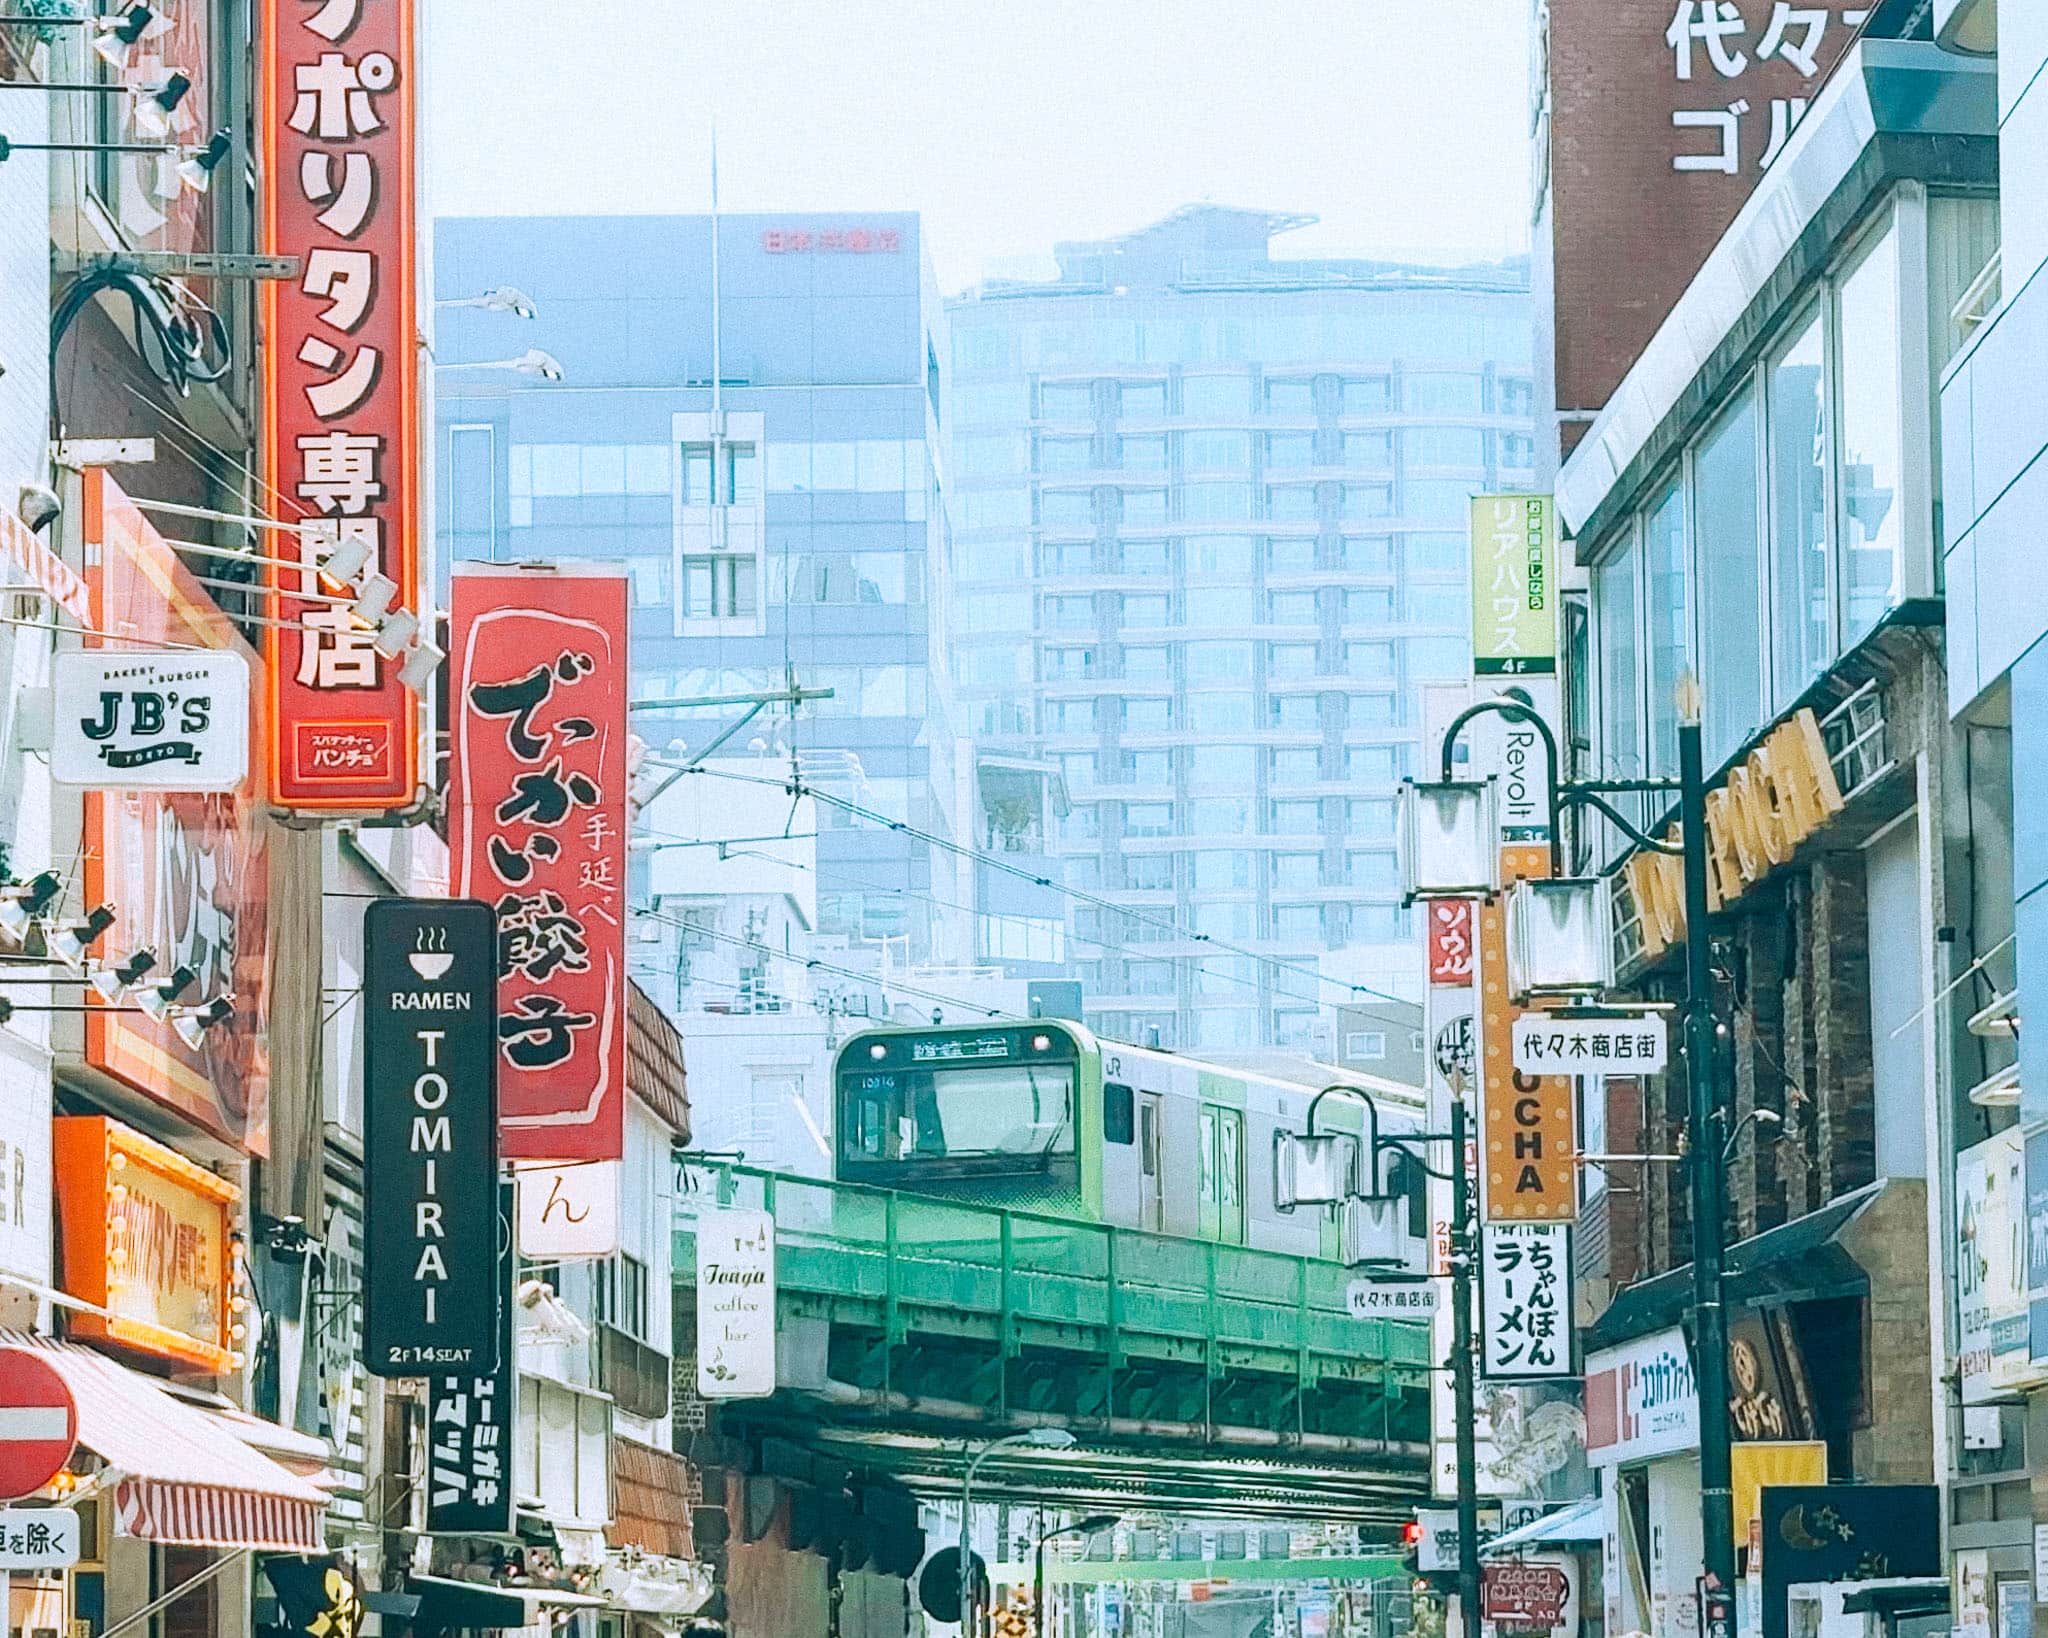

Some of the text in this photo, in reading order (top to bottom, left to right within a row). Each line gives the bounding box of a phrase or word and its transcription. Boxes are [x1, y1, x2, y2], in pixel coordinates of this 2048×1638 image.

[1665, 0, 1869, 80] 代々
[1491, 500, 1521, 655] リアハウス
[104, 666, 154, 680] BAKERY
[159, 670, 209, 682] BURGER
[1502, 658, 1526, 673] 4F
[126, 746, 174, 763] TOKYO
[1506, 732, 1535, 817] Revolt
[1435, 906, 1473, 975] ソウル
[392, 992, 471, 1010] RAMEN
[1524, 1032, 1656, 1060] 代々木商店街
[411, 1031, 452, 1323] TOMIRAI
[1354, 1291, 1434, 1308] 代々木商店街
[1494, 1242, 1525, 1367] ラーメン
[1526, 1240, 1557, 1366] ちゃんぽん
[389, 1347, 411, 1363] 2F
[0, 1523, 66, 1555] を除く
